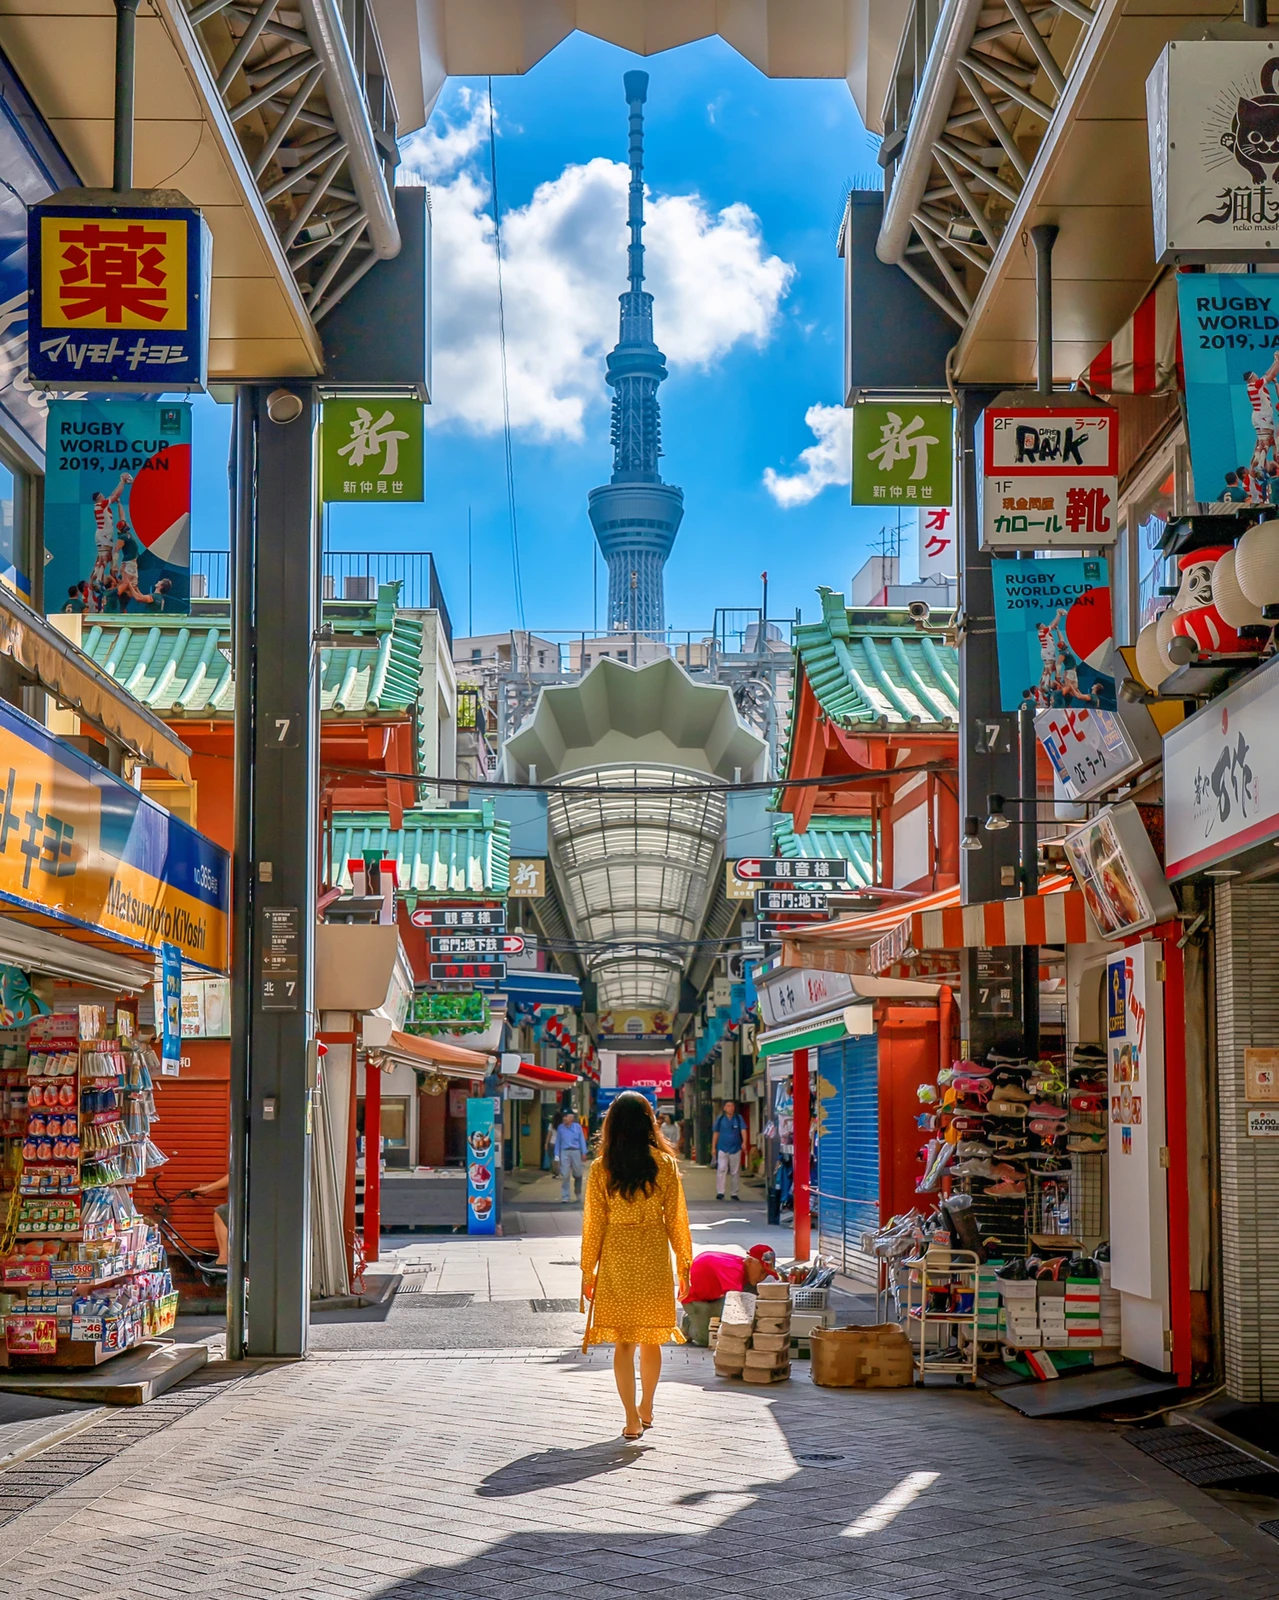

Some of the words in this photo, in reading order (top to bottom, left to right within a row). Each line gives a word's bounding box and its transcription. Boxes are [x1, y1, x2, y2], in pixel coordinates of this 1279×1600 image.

[1233, 222, 1252, 231] neko
[59, 224, 169, 323] 薬
[1197, 296, 1272, 312] RUGBY
[1197, 315, 1279, 331] WORLD
[1199, 333, 1255, 351] 2019,
[39, 335, 189, 371] マツモトキヨシ
[60, 422, 125, 436] RUGBY
[994, 418, 1014, 430] 2F
[1074, 418, 1108, 431] ラーク
[59, 439, 128, 453] WORLD
[131, 439, 170, 453] CUP
[337, 407, 410, 476] 新
[867, 411, 940, 481] 新
[59, 458, 105, 473] 2019,
[108, 458, 169, 471] JAPAN
[343, 480, 404, 495] 新仲見世
[873, 485, 933, 499] 新仲見世
[994, 481, 1013, 494] 1F
[1065, 487, 1111, 533] 靴
[993, 514, 1063, 533] カロール
[1005, 573, 1055, 585] RUGBY
[1006, 585, 1061, 597] WORLD
[1062, 584, 1094, 595] CUP
[1007, 598, 1044, 610] 2019,
[1046, 596, 1095, 608] JAPAN
[275, 719, 290, 742] 7
[985, 724, 1000, 747] 7
[1085, 748, 1107, 777] ラーク
[1073, 762, 1088, 785] 2F
[512, 862, 541, 889] 新
[774, 861, 830, 877] 観音様
[106, 876, 172, 938] Matsumoto
[172, 906, 207, 951] KiYoshi
[444, 911, 491, 925] 観音様
[444, 964, 492, 978] 仲見世
[264, 981, 275, 992] 北
[285, 981, 296, 997] 7
[979, 988, 990, 1004] 7
